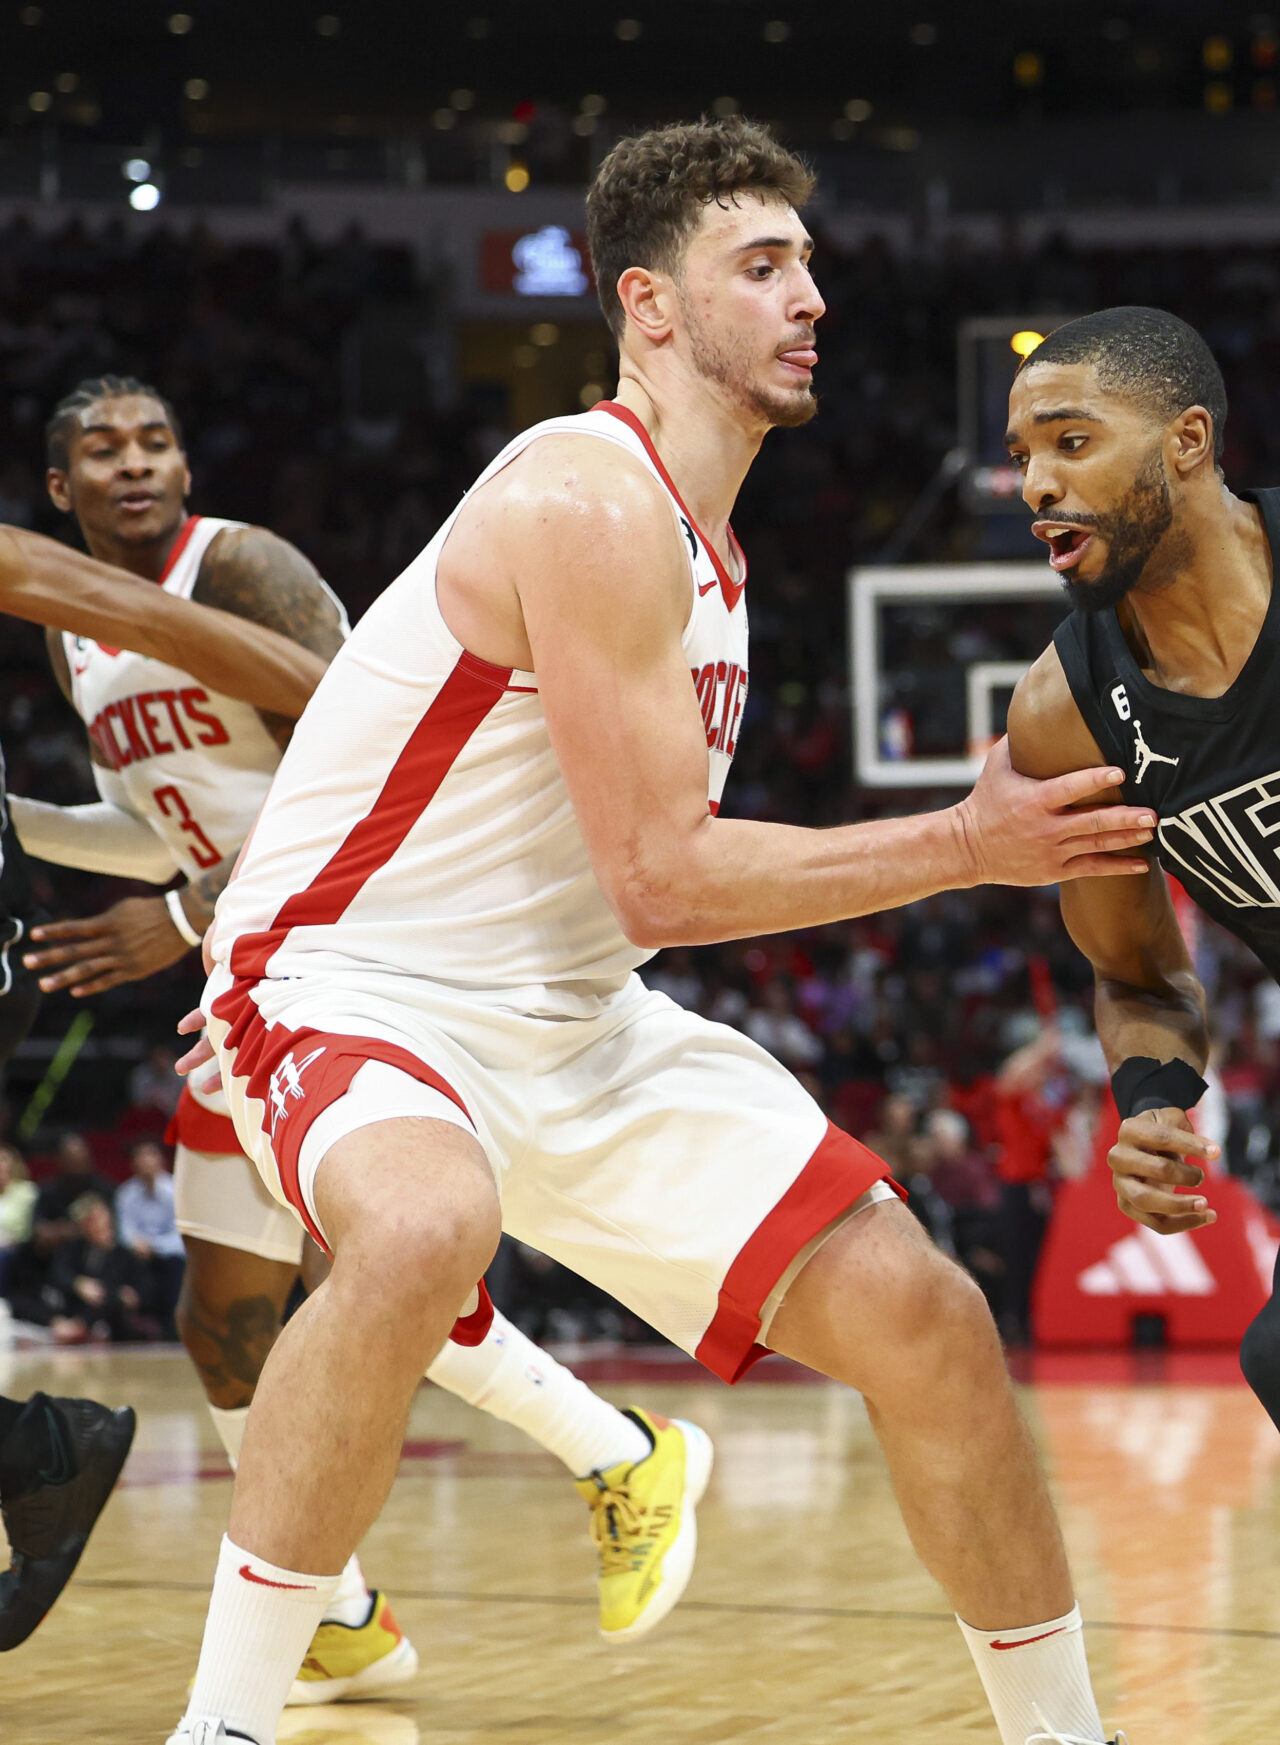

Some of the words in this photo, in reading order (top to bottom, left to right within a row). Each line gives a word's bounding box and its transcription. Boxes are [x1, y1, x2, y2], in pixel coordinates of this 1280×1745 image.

[88, 688, 230, 773] OCKETS
[1110, 683, 1132, 722] 6
[152, 785, 223, 869] 3
